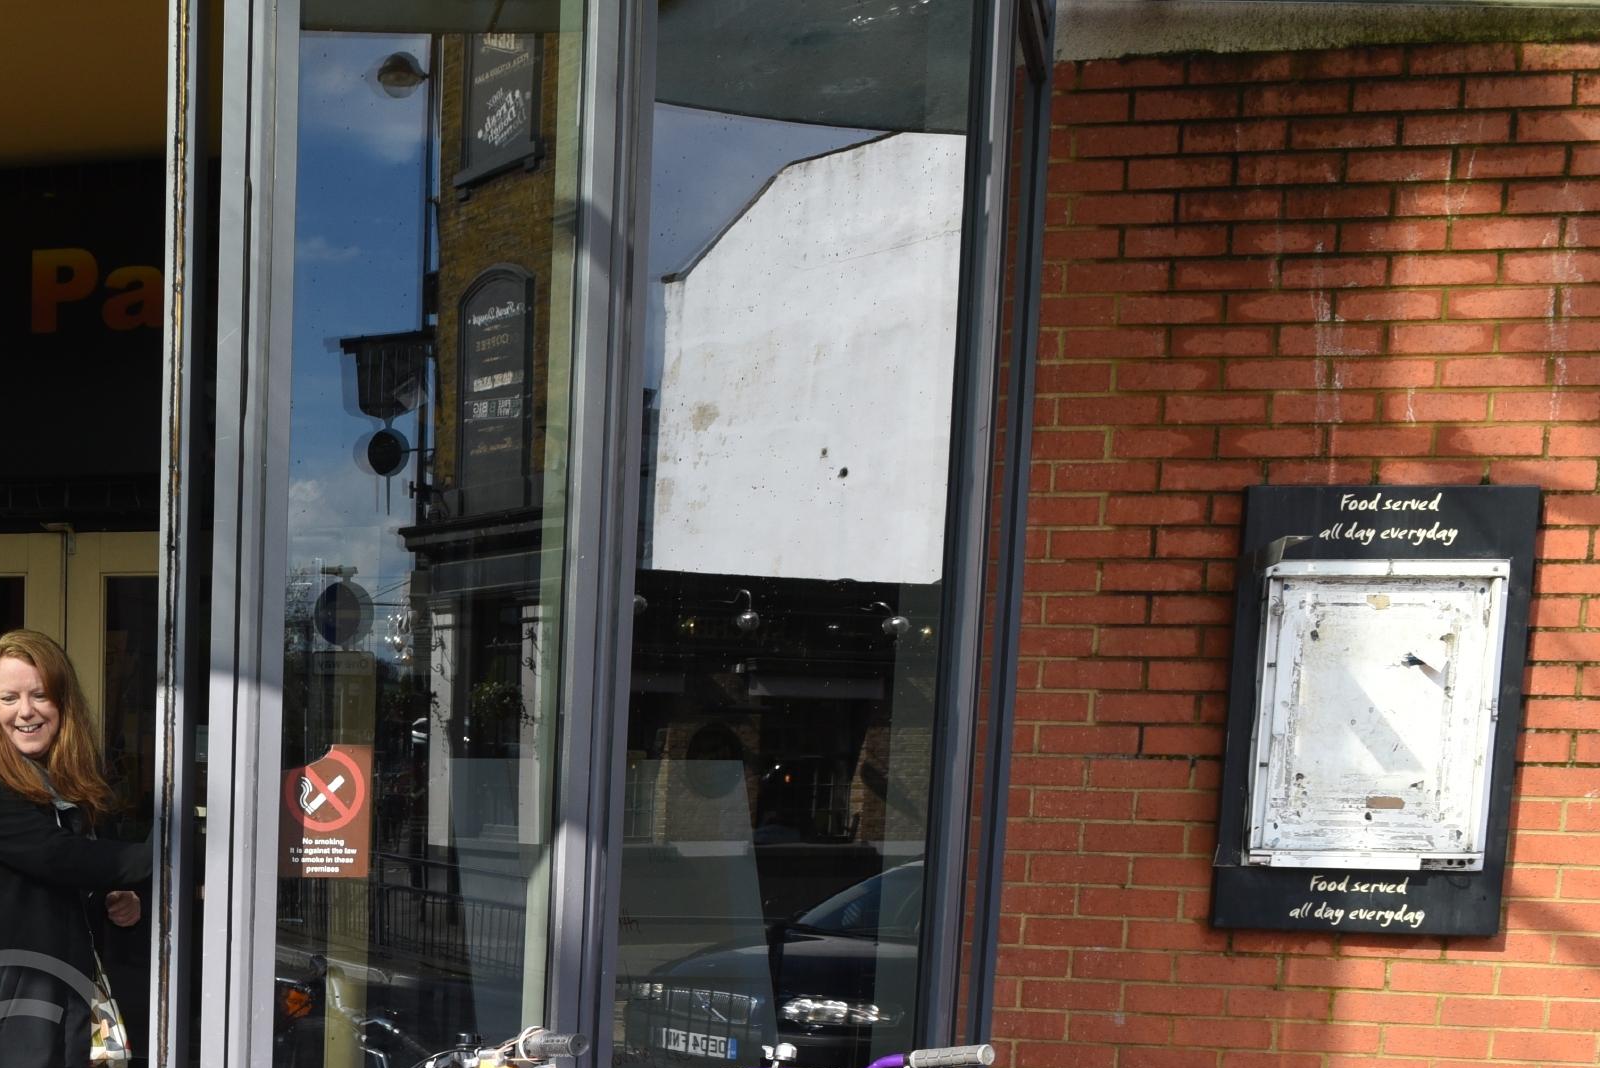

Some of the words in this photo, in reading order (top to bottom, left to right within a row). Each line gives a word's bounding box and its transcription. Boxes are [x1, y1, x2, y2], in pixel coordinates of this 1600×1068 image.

[31, 247, 165, 335] Pa
[1340, 492, 1382, 511] Food
[1382, 492, 1443, 511] served
[1319, 523, 1344, 541] all
[1344, 521, 1376, 546] day
[1380, 521, 1459, 546] everyday
[302, 837, 314, 845] No
[314, 837, 345, 847] smoking
[303, 847, 330, 855] against
[305, 865, 339, 873] premises
[1310, 874, 1350, 893] Food
[1350, 876, 1410, 895] served
[1289, 902, 1312, 919] all
[1314, 901, 1344, 926] day
[1349, 903, 1425, 928] everyday
